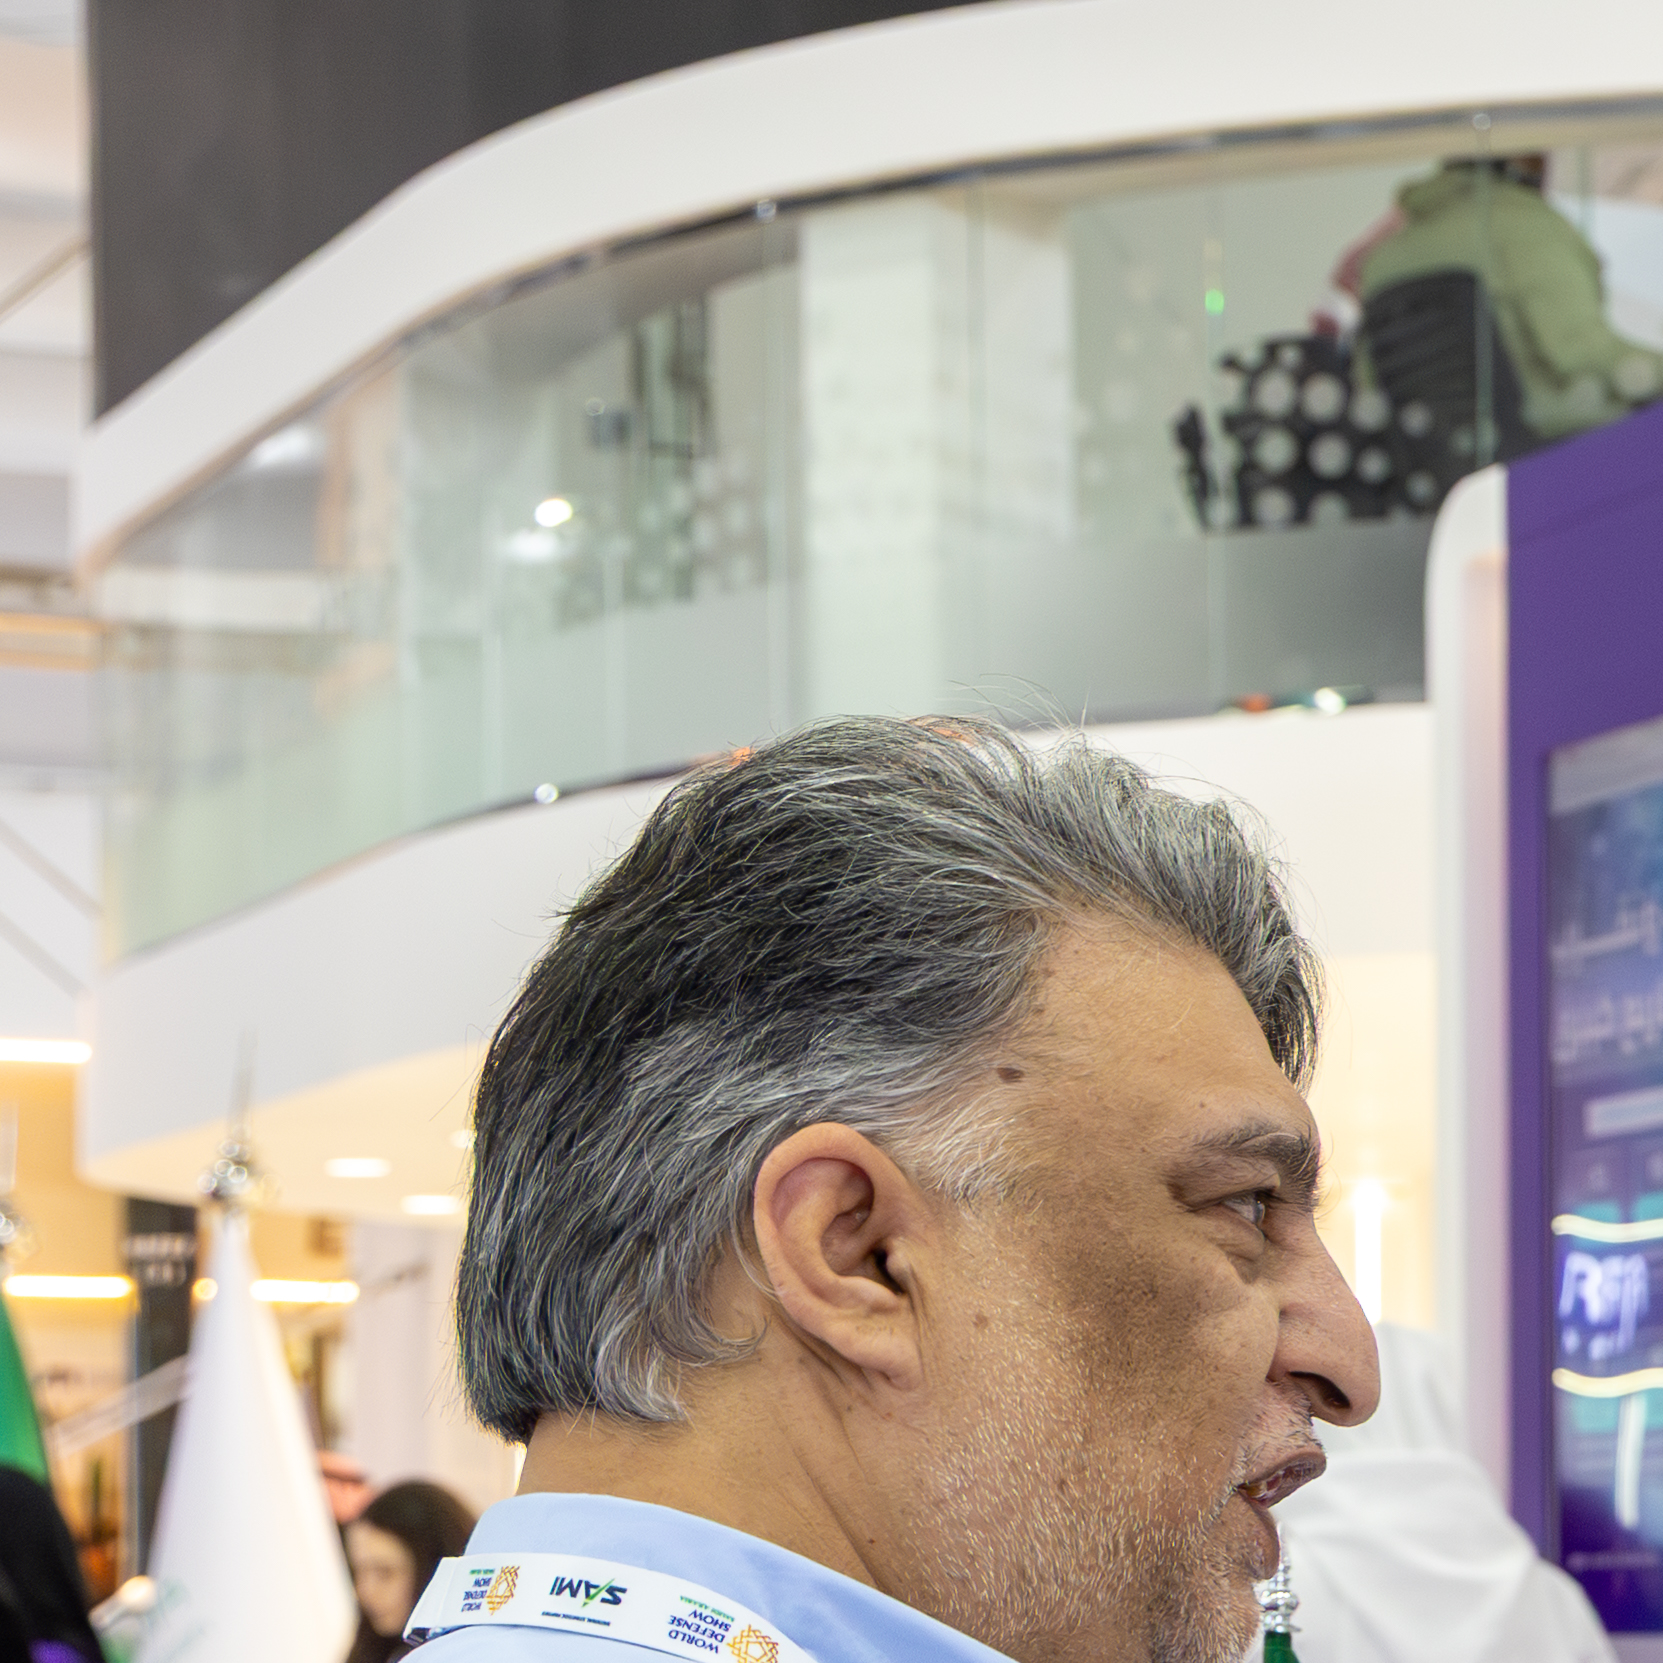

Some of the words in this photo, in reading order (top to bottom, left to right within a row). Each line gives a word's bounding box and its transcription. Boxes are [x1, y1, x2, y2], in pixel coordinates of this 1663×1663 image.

[548, 1576, 628, 1608] SAMI
[667, 1614, 726, 1643] DEFENSE
[688, 1609, 732, 1632] SHOW
[668, 1629, 718, 1654] WORLD
